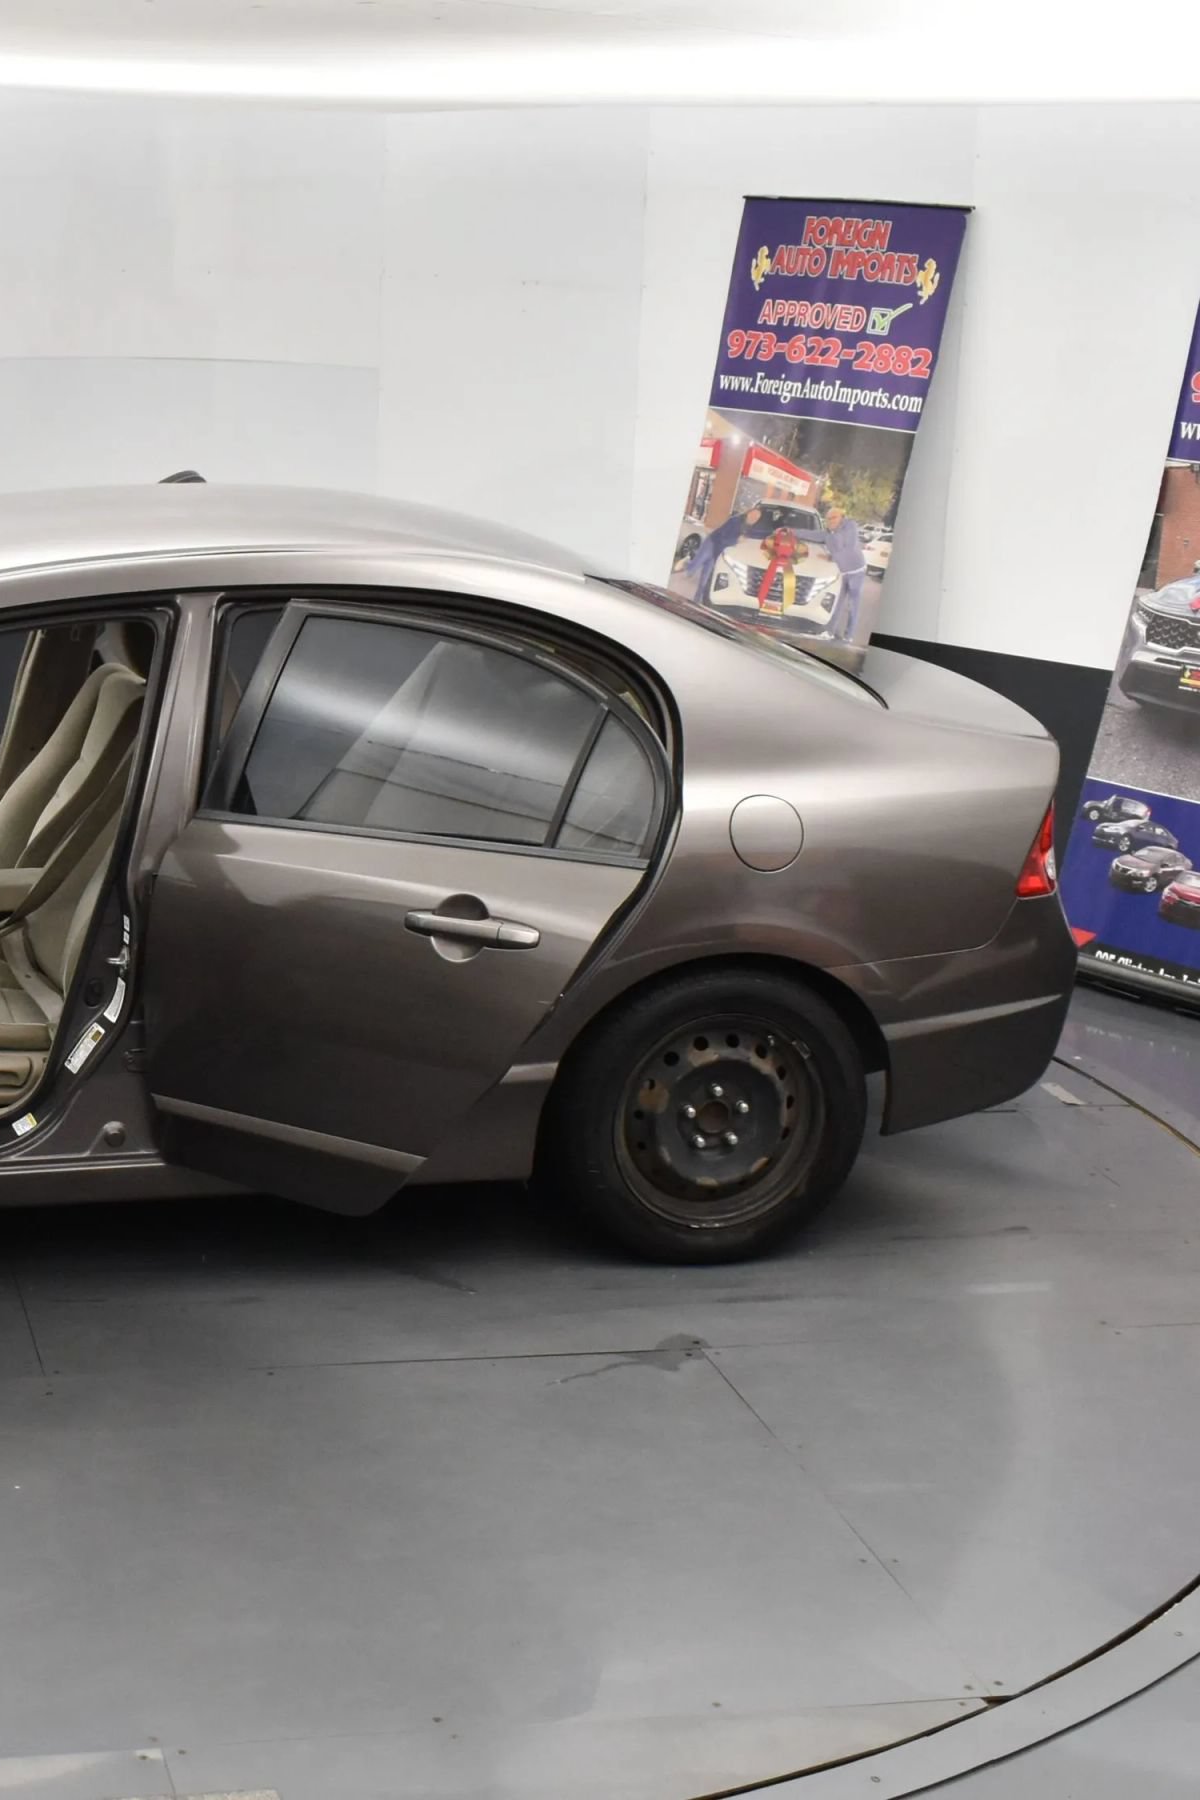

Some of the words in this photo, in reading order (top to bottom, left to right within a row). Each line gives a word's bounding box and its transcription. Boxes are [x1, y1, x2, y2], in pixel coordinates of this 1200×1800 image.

[802, 216, 892, 250] FOREIGN
[768, 246, 826, 277] AUTO
[827, 250, 919, 286] IMPORTS
[757, 299, 868, 333] APPROVED
[727, 329, 932, 379] 973-622-2882
[719, 372, 923, 413] www.ForeignAutoImports.com
